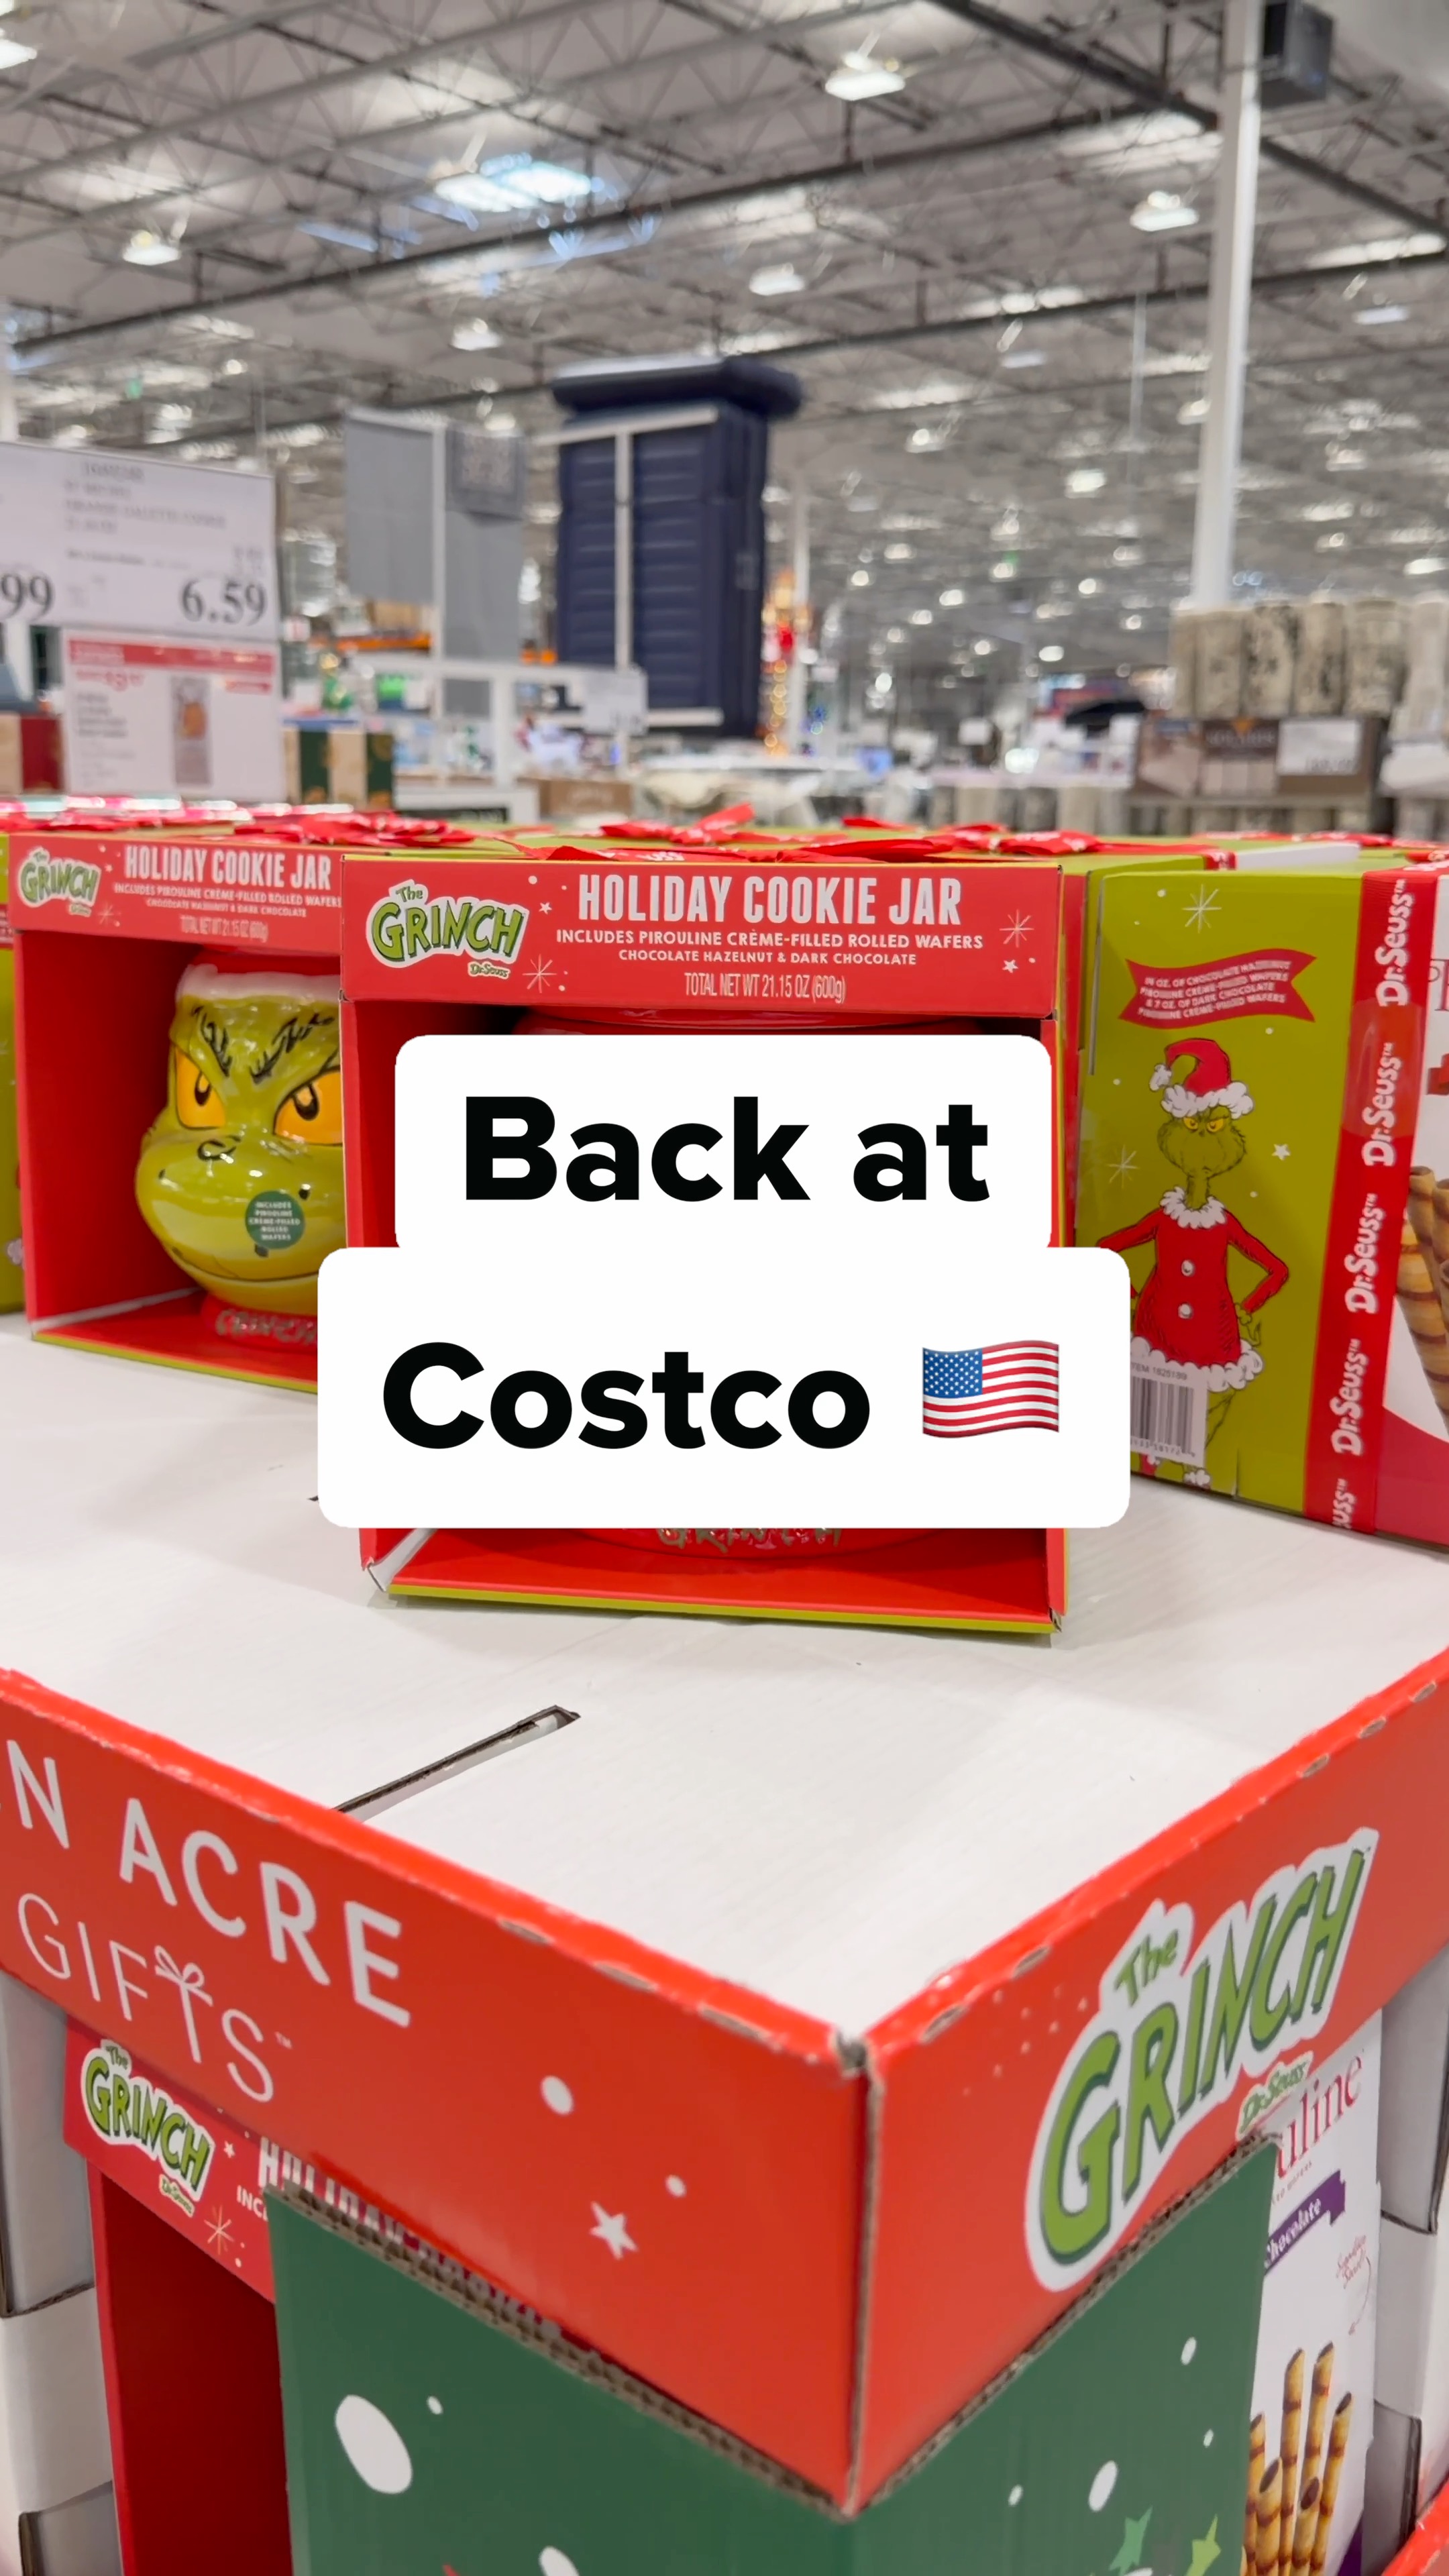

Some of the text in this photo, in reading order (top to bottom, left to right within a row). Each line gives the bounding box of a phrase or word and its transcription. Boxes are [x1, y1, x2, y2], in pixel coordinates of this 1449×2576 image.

[182, 577, 268, 626] 6.59
[21, 862, 99, 904] GRINCH
[125, 845, 331, 890] HOLIDAY COOKIE JAR
[396, 885, 423, 903] The
[579, 874, 961, 926] HOLIDAY COOKIE JAR
[371, 900, 526, 962] GRINCH
[556, 928, 983, 949] INCLUDES PIROULINE CRÈME-FILLED ROLLED WAFERS
[619, 949, 916, 966] CHOCOLATE HAZELNUT & DARK CHOCOLATE
[684, 972, 717, 996] TOTAL
[720, 973, 741, 997] NET
[742, 973, 760, 998] WT
[761, 974, 792, 998] 21.15
[794, 975, 810, 999] OZ
[0, 1739, 411, 2028] N ACRE
[1114, 1929, 1179, 2008] The
[105, 2044, 129, 2070] The
[1039, 1845, 1367, 2265] GRINCH
[85, 2056, 212, 2192] GRINCH
